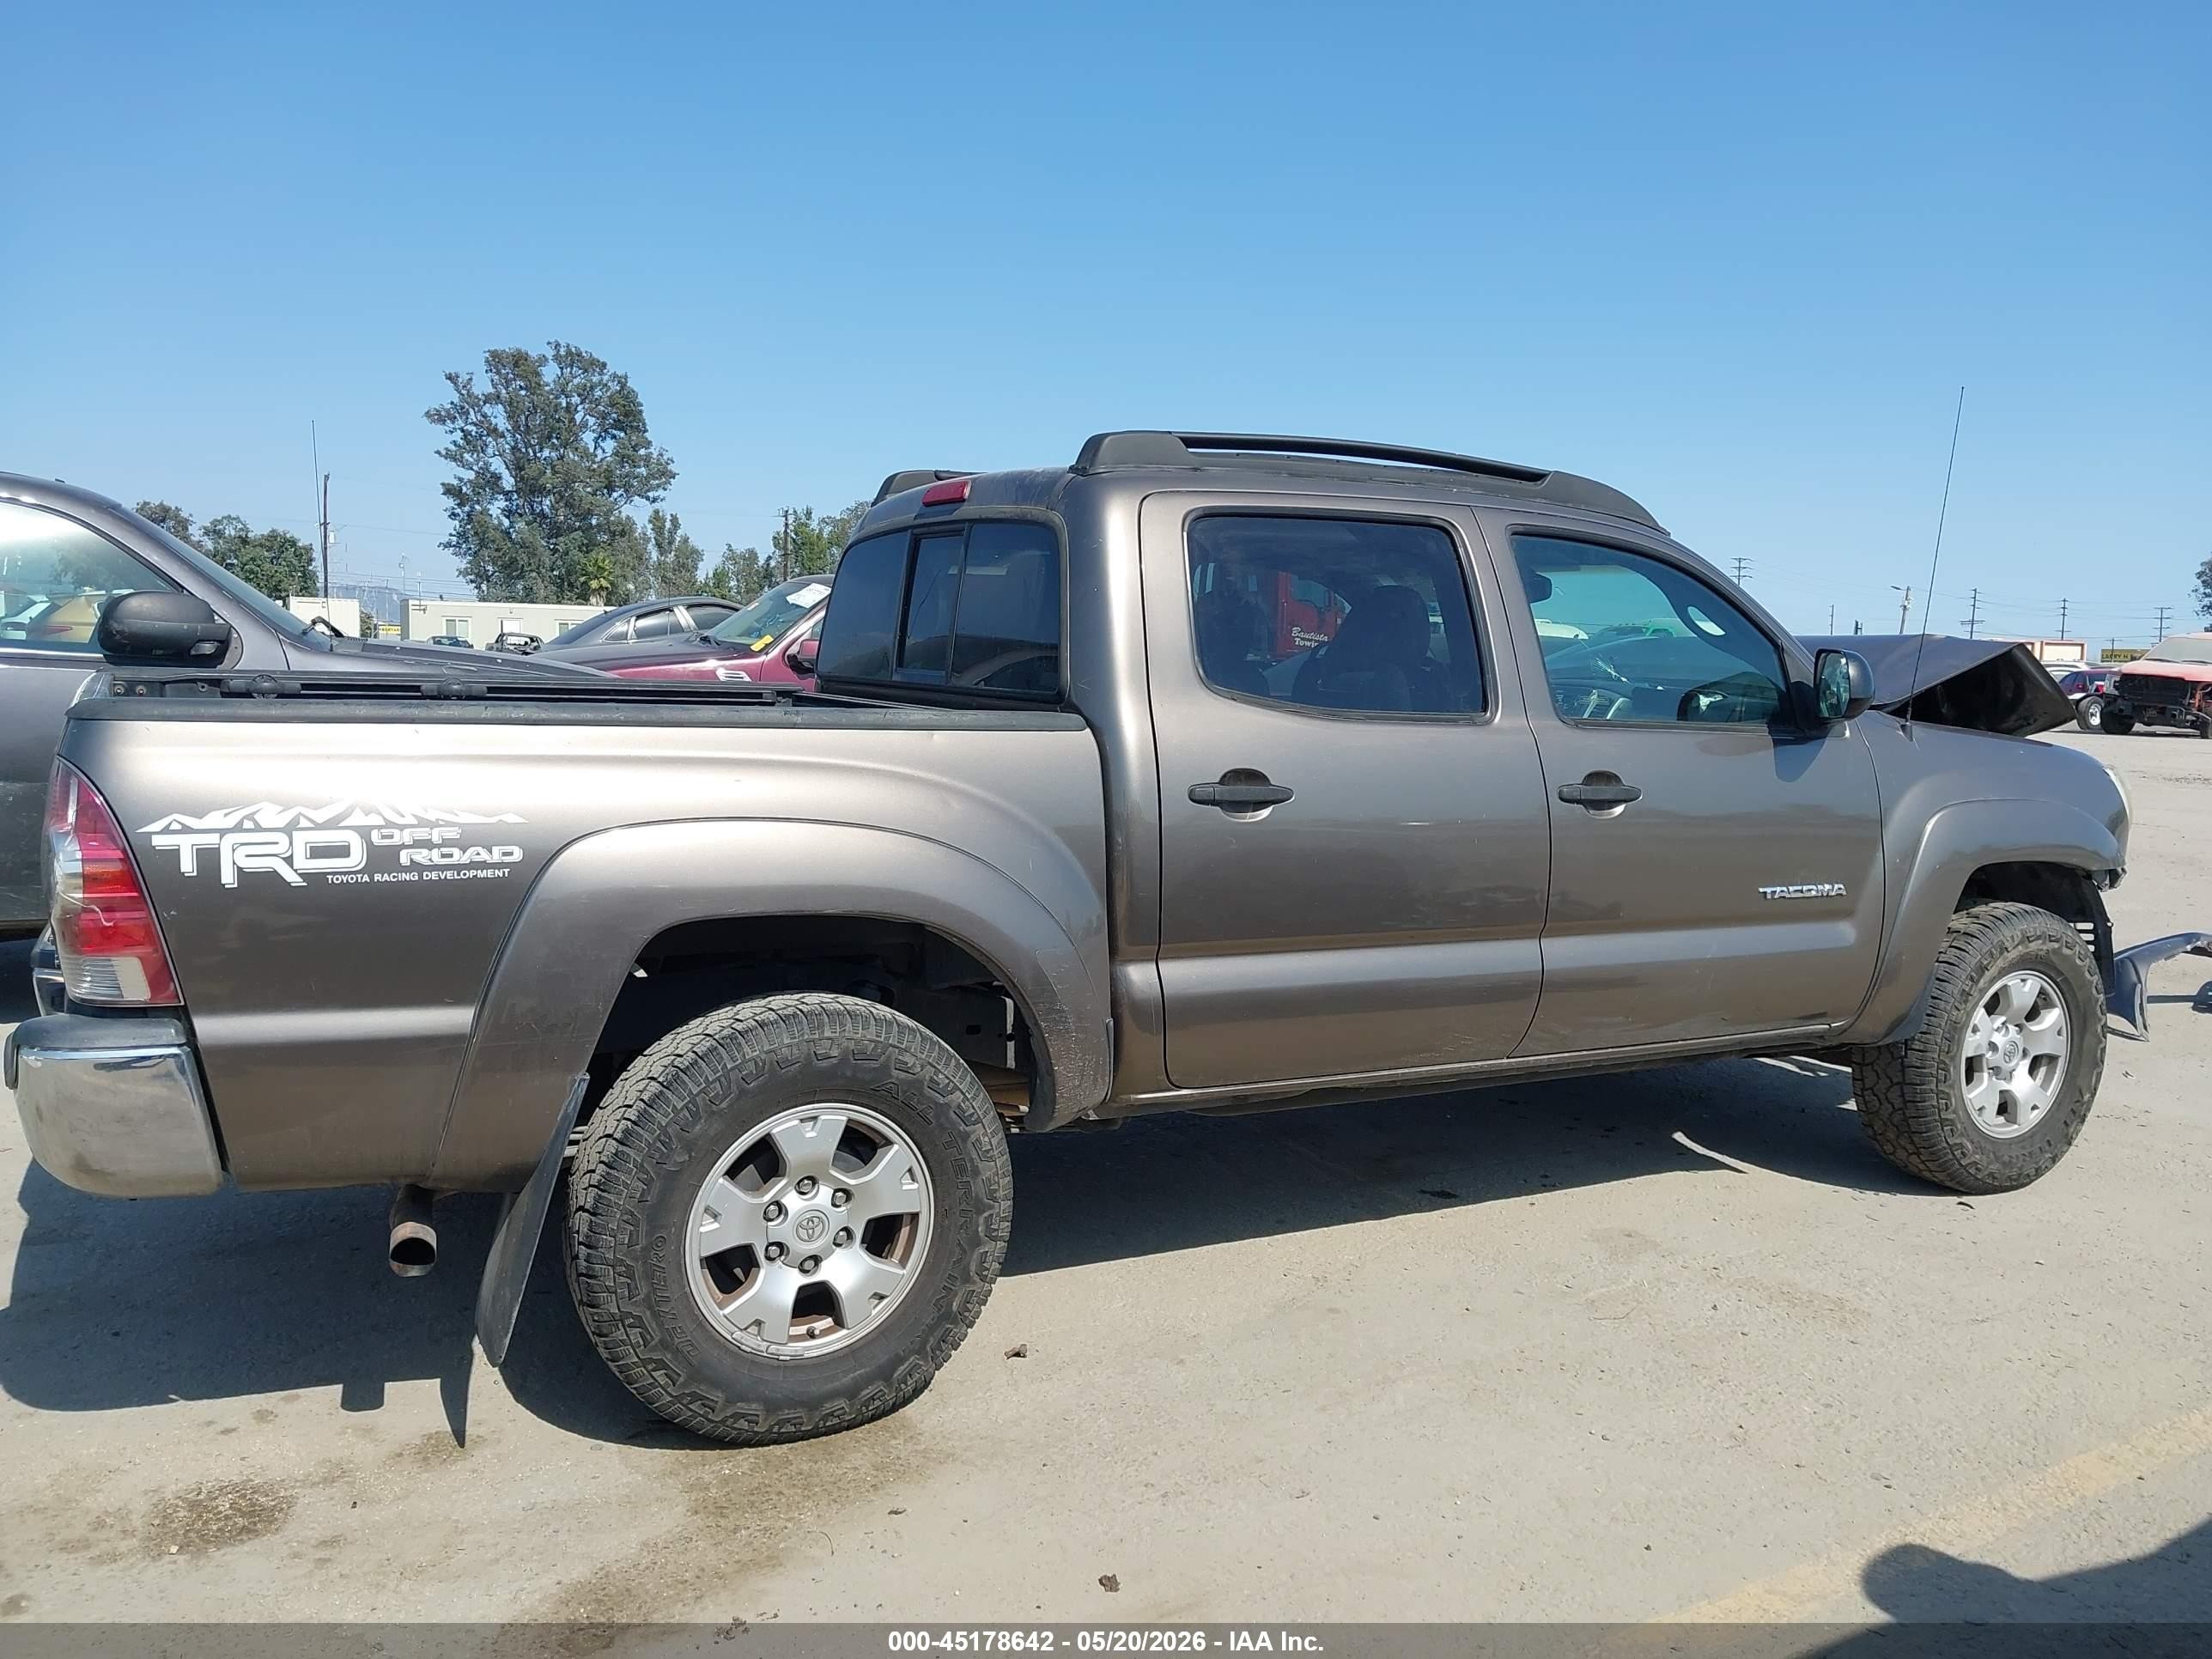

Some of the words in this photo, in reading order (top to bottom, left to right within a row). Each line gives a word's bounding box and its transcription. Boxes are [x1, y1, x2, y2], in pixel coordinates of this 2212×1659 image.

[1291, 627, 1328, 641] Bautista
[370, 826, 462, 846] OFF
[151, 830, 367, 888] TRD
[399, 845, 523, 866] ROAD
[326, 874, 370, 884] TOYOTA
[374, 872, 419, 883] RACING
[422, 868, 511, 881] DEVELOPMENT
[1758, 883, 1848, 900] TACOMA
[870, 1080, 934, 1127] ALL
[932, 1131, 974, 1314] TERRAIN
